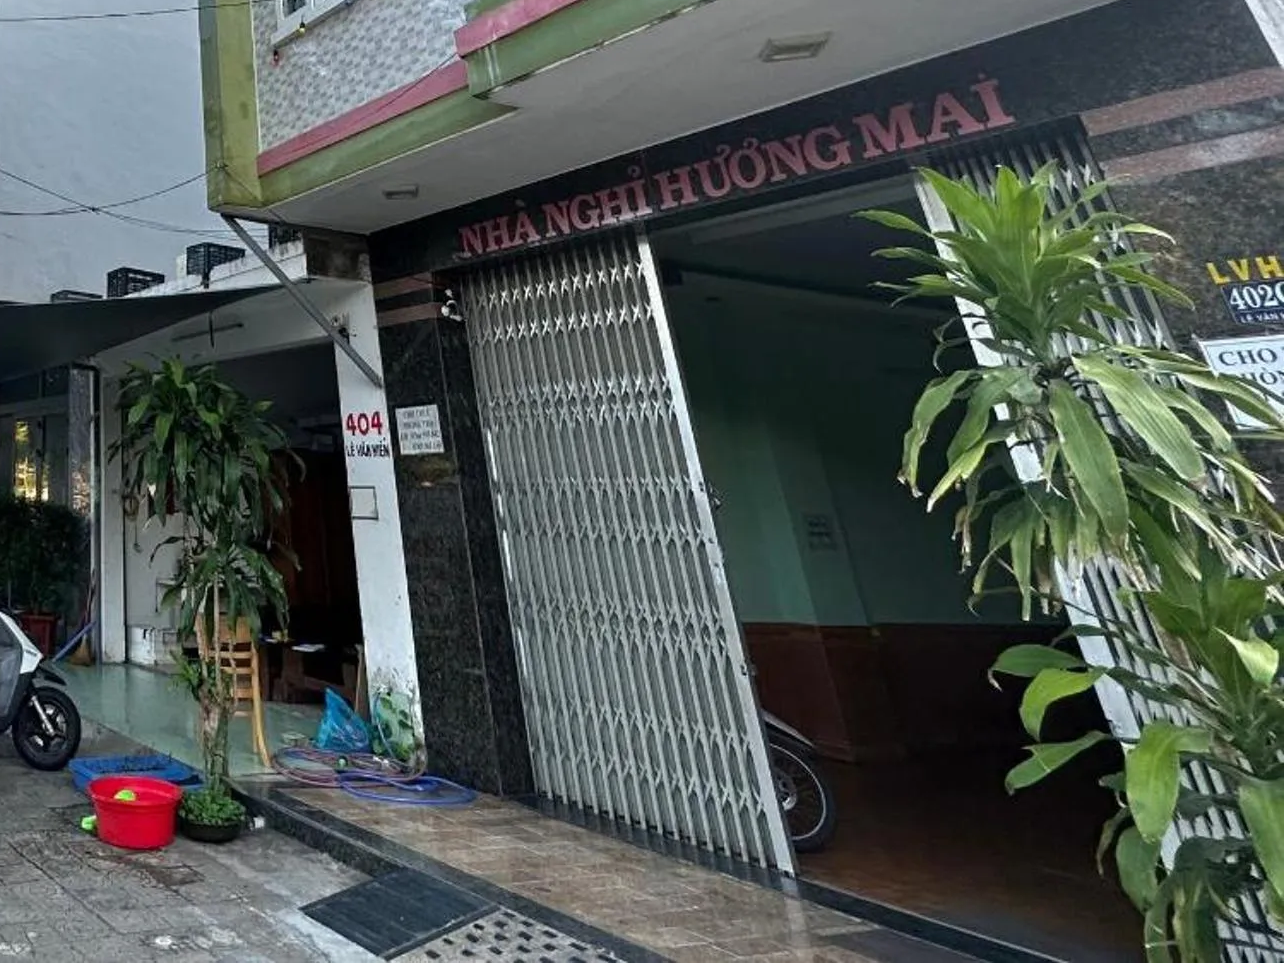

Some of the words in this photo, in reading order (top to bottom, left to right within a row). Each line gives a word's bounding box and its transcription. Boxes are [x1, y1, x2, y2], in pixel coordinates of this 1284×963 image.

[458, 199, 541, 259] NHÀ
[541, 165, 653, 237] NGHỈ
[1218, 348, 1278, 366] CHO
[346, 411, 383, 436] 404
